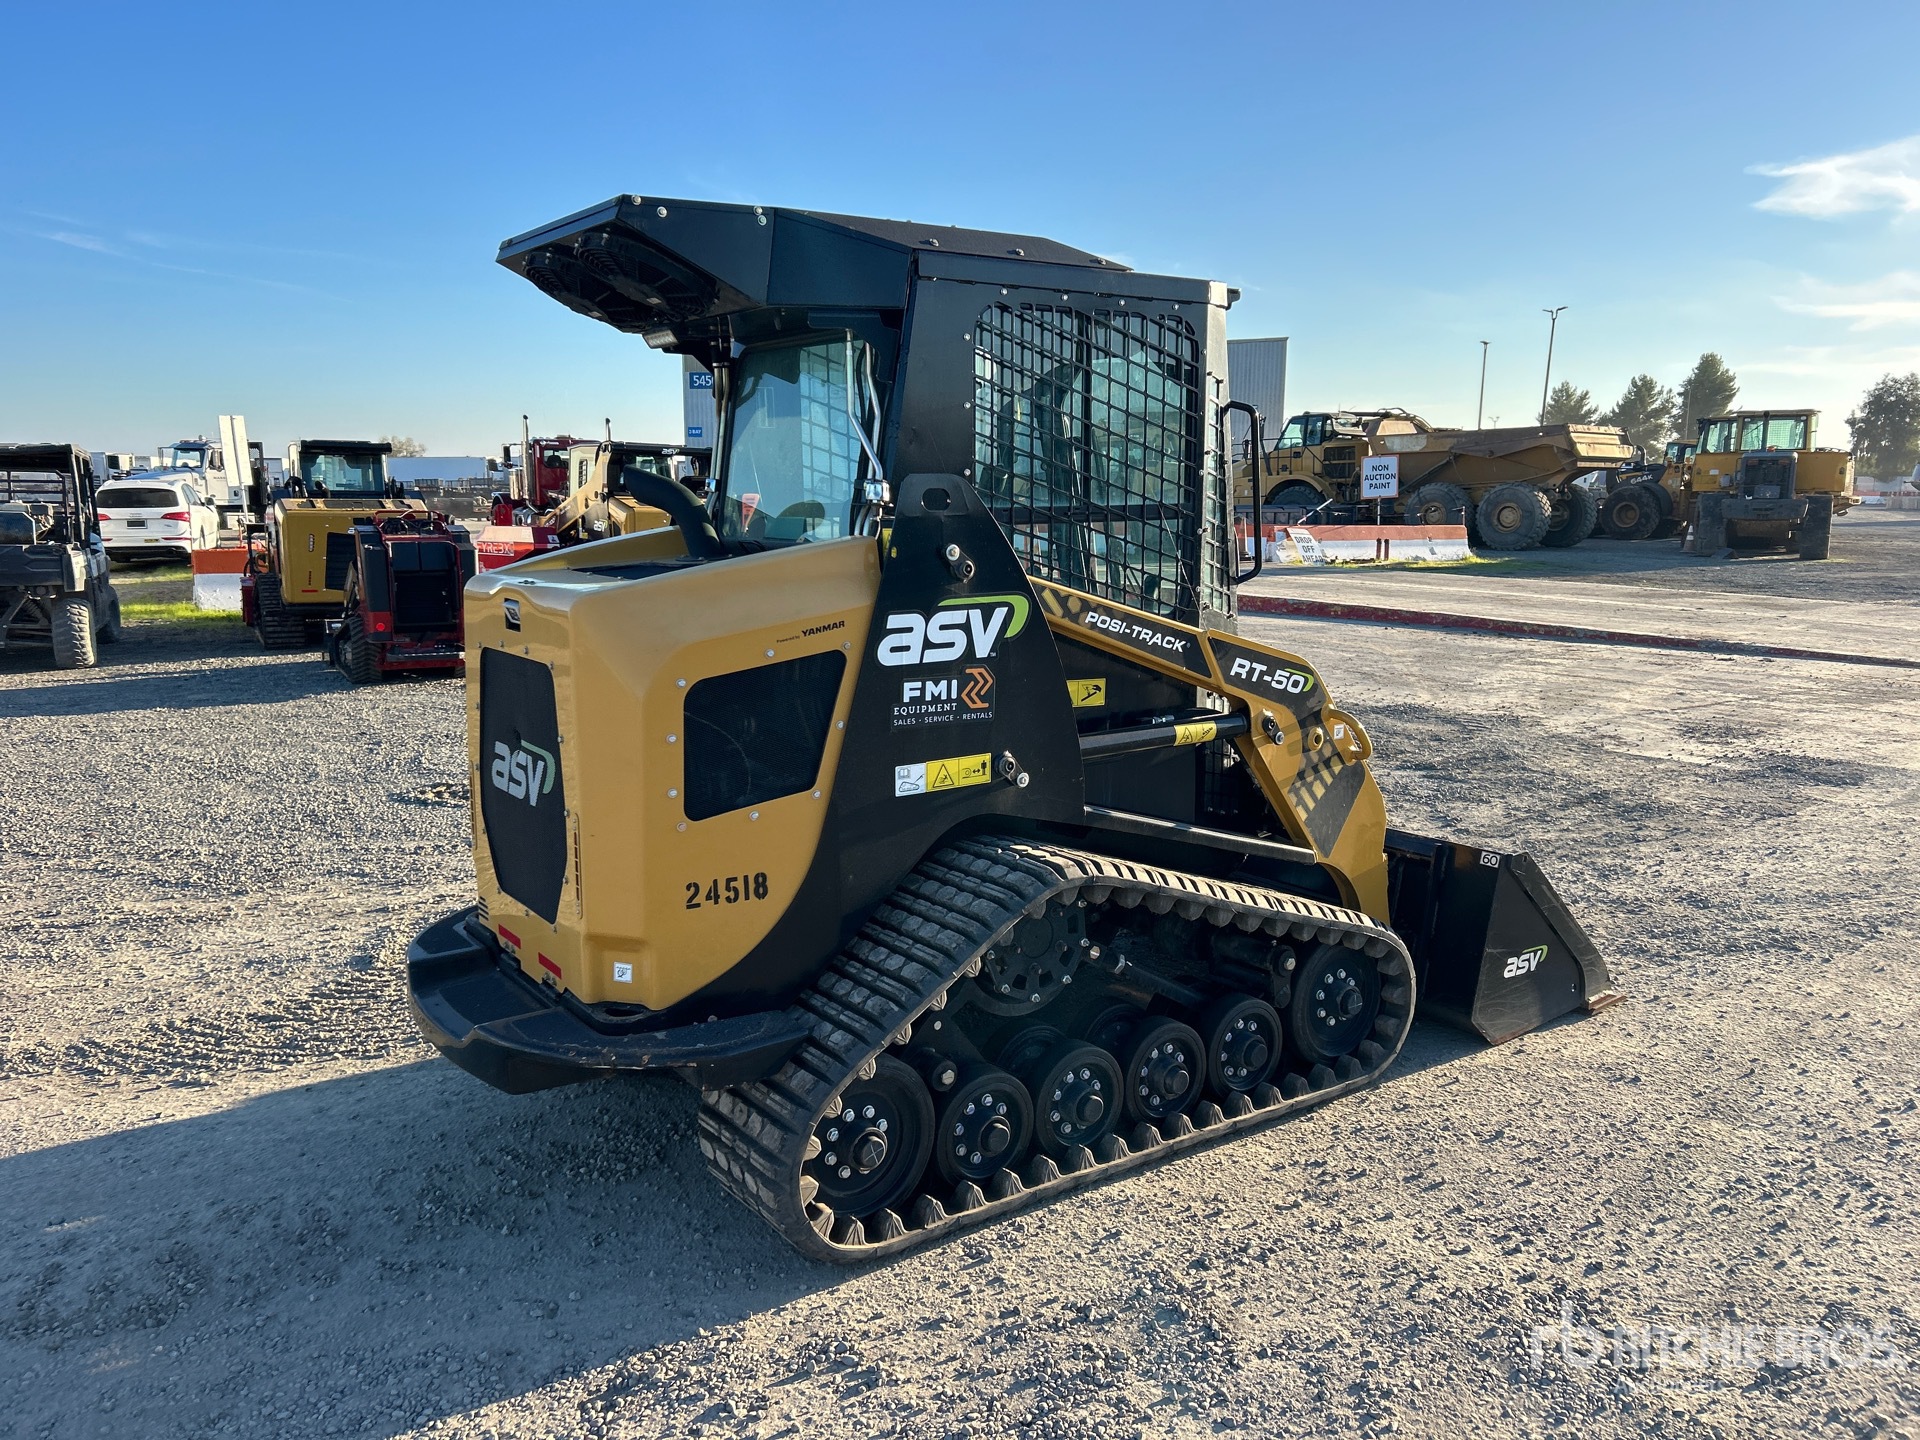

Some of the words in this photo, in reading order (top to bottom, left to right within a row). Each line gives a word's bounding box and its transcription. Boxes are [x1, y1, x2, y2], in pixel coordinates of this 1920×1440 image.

[693, 375, 713, 386] 545
[1371, 464, 1389, 472] NON
[1364, 473, 1396, 482] AUCTION
[1368, 482, 1391, 490] PAINT
[1294, 536, 1312, 544] DROP
[1302, 545, 1315, 553] OFF
[1302, 555, 1324, 563] AHEAD
[801, 620, 845, 637] YANMAR
[1084, 611, 1188, 653] POSI-TRACK
[1229, 657, 1306, 694] RT-50
[903, 679, 958, 703] FMI
[893, 703, 958, 716] EQUIPMENT
[893, 718, 916, 726] SALES
[924, 714, 954, 724] SERVICE
[962, 711, 993, 720] RENTALS
[1483, 854, 1498, 866] 60
[684, 872, 770, 910] 24518
